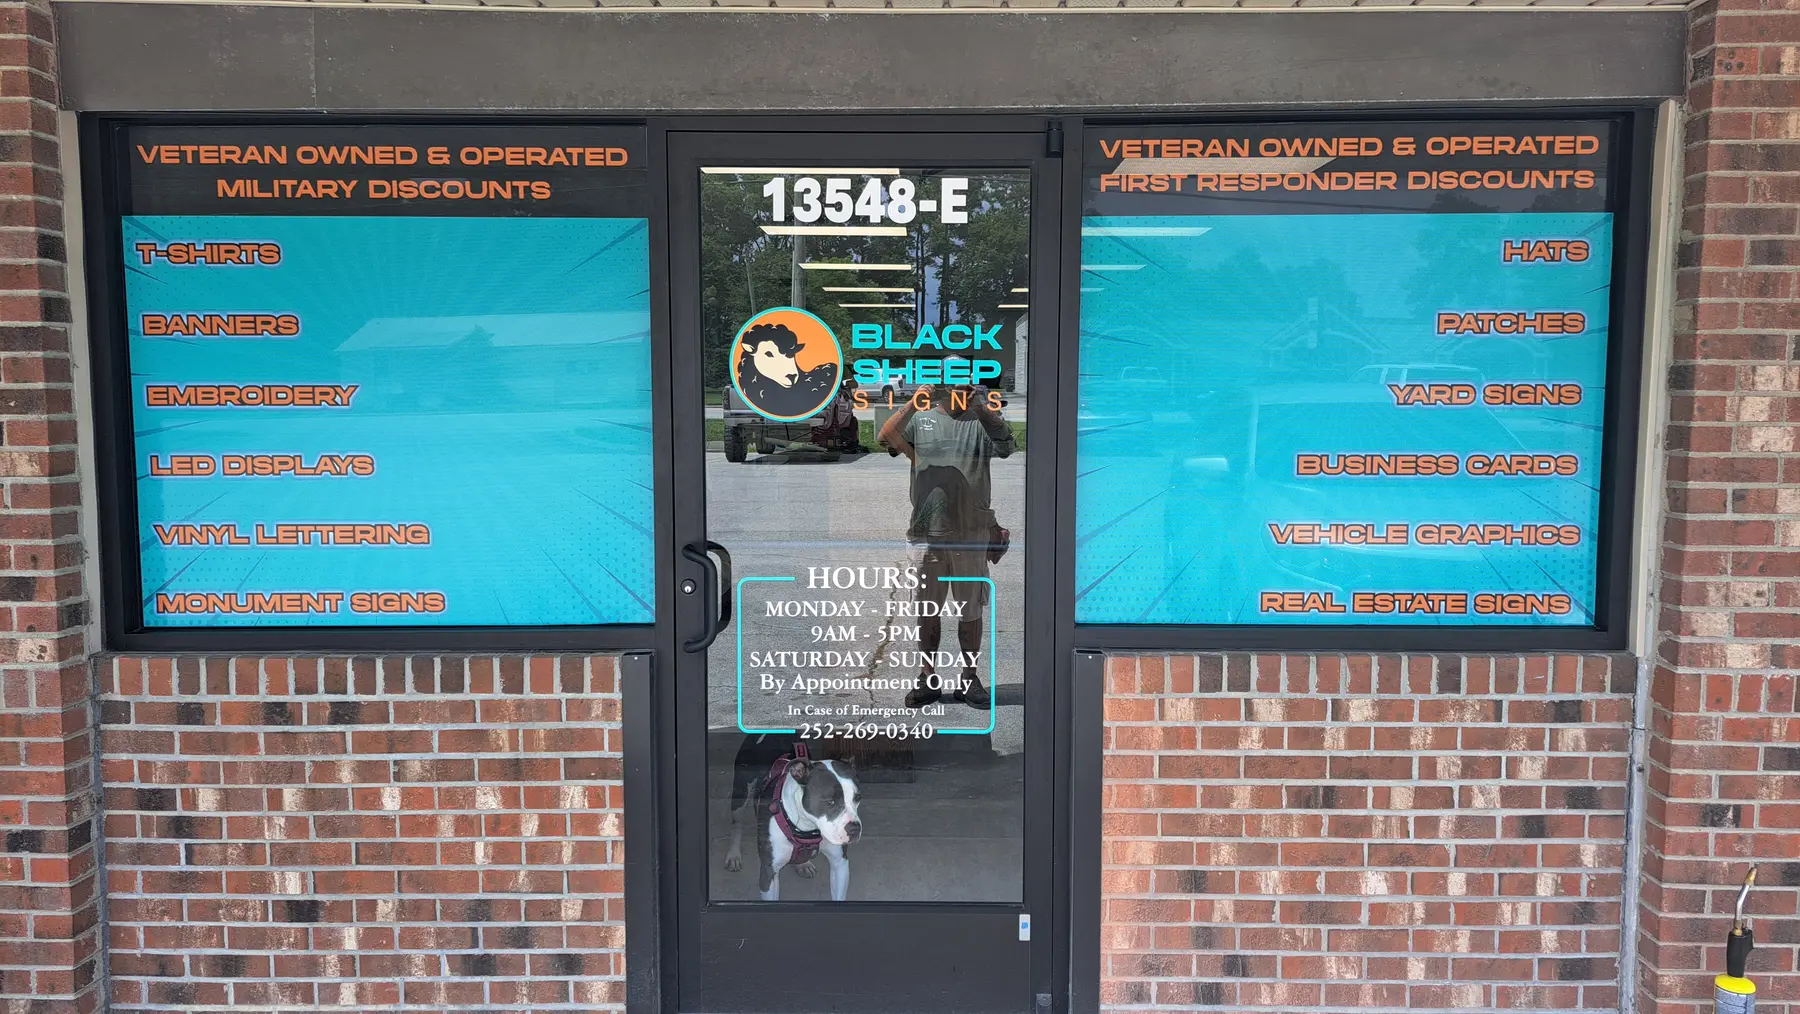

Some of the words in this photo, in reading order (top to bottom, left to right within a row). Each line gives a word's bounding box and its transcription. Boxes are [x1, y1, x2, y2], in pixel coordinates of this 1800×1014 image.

[137, 145, 288, 165] VETERAN
[296, 146, 418, 166] OWNED
[427, 146, 451, 166] &
[459, 146, 628, 167] OPERATED
[1099, 138, 1250, 159] VETERAN
[1259, 137, 1383, 157] OWNED
[1392, 137, 1416, 156] &
[1425, 135, 1599, 156] OPERATED
[217, 178, 358, 199] MILITARY
[368, 179, 551, 200] DISCOUNTS
[1101, 173, 1189, 193] FIRST
[1196, 171, 1398, 193] RESPONDER
[1407, 170, 1595, 191] DISCOUNTS
[762, 177, 969, 224] 13548-E
[136, 242, 281, 265] T-SHIRTS
[1503, 240, 1590, 263] HATS
[142, 313, 300, 336] BANNERS
[1436, 312, 1586, 335] PATCHES
[851, 323, 1004, 350] BLACK
[853, 359, 1002, 385] SHEEP
[145, 384, 359, 407] EMBROIDERY
[853, 391, 1003, 411] SIGNS
[1387, 383, 1476, 406] YARD
[1482, 383, 1583, 406] SIGNS
[149, 454, 217, 476] LED
[222, 454, 375, 476] DISPLAYS
[1296, 453, 1458, 476] BUSINESS
[1465, 454, 1578, 476] CARDS
[152, 523, 250, 546] VINYL
[255, 523, 430, 546] LETTERING
[1267, 523, 1409, 546] VEHICLE
[1414, 523, 1581, 546] GRAPHICS
[806, 566, 928, 591] HOURS:
[156, 592, 344, 614] MONUMENT
[349, 592, 446, 613] SIGNS
[765, 600, 865, 617] MONDAY
[884, 600, 968, 617] FRIDAY
[1259, 591, 1346, 614] REAL
[1352, 592, 1467, 614] ESTATE
[1473, 592, 1573, 615] SIGNS
[811, 624, 857, 643] 9AM
[877, 624, 922, 643] 5PM
[750, 651, 870, 668] SATURDAY
[889, 651, 983, 668] SUNDAY
[760, 673, 785, 694] By
[791, 674, 920, 694] Appointment
[926, 673, 973, 694] Only
[788, 705, 802, 716] In
[804, 705, 833, 716] Case
[835, 705, 849, 716] of
[852, 705, 918, 719] Emergency
[921, 704, 945, 716] Call
[800, 722, 933, 741] 252-269-0340
